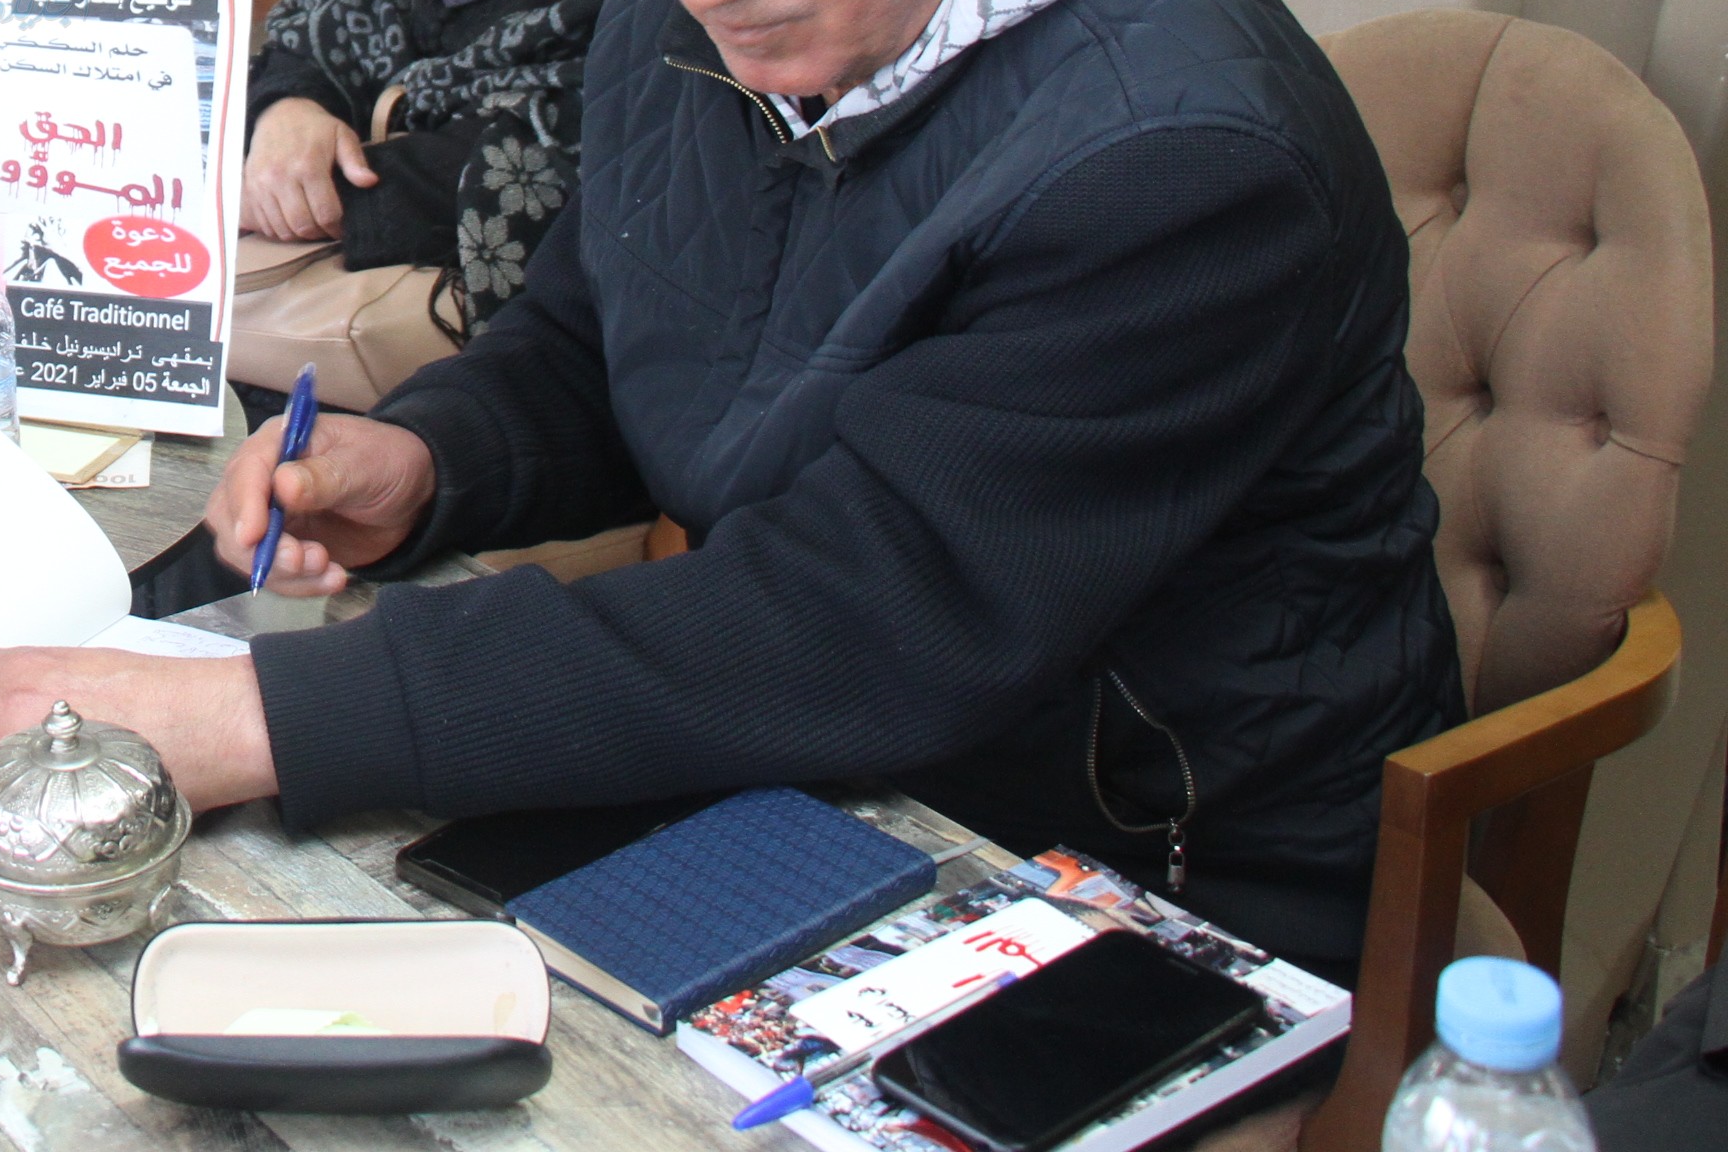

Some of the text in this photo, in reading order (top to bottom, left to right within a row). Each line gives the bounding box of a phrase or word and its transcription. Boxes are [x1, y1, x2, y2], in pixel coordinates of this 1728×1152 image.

[109, 43, 148, 58] حلم
[73, 65, 142, 83] امتلاك
[147, 71, 173, 92] في
[19, 111, 123, 154] الحق
[110, 219, 177, 247] دعوة
[103, 252, 192, 280] للجميع
[20, 296, 191, 332] Café Traditionnel
[151, 346, 214, 370] بمقهى
[30, 361, 79, 385] 2021
[84, 368, 128, 391] فبراير
[132, 371, 158, 393] 05
[161, 370, 211, 399] الجمعة
